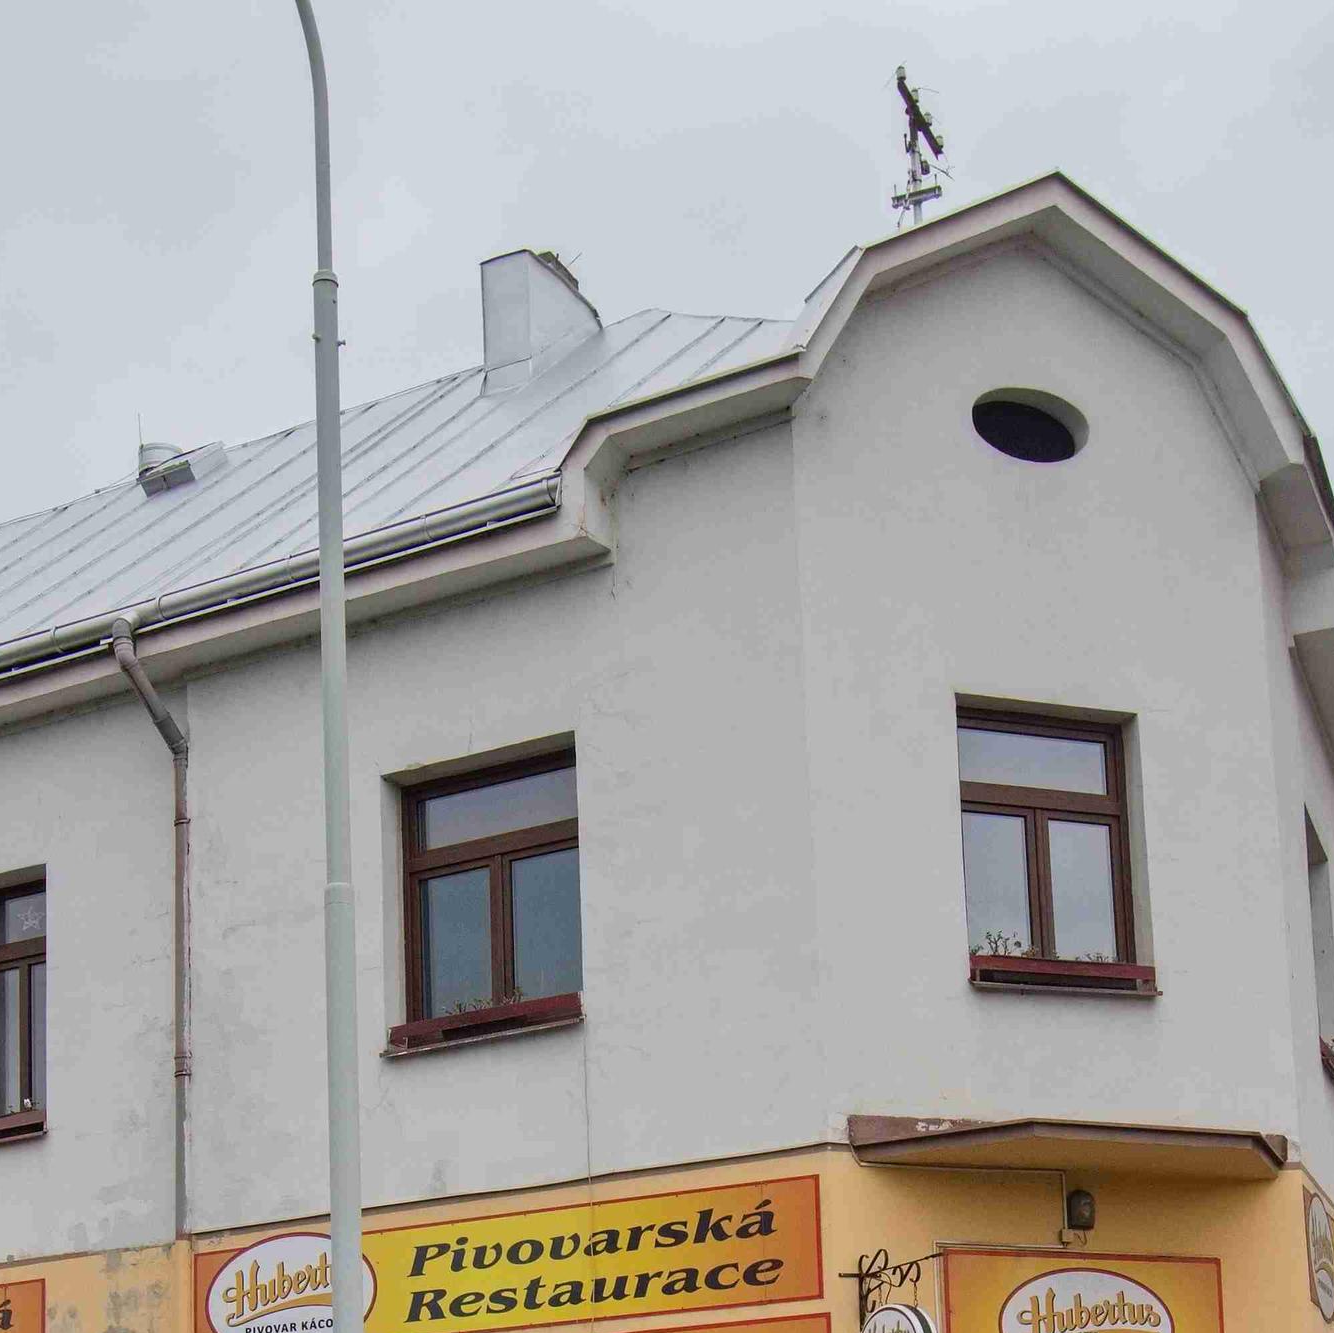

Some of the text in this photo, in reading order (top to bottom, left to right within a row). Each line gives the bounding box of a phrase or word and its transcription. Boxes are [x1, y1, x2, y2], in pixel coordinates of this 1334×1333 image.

[409, 1199, 775, 1278] Pivovarská
[222, 1252, 332, 1318] Hubert
[405, 1258, 785, 1324] Restaurace
[301, 1317, 334, 1331] KÁCO
